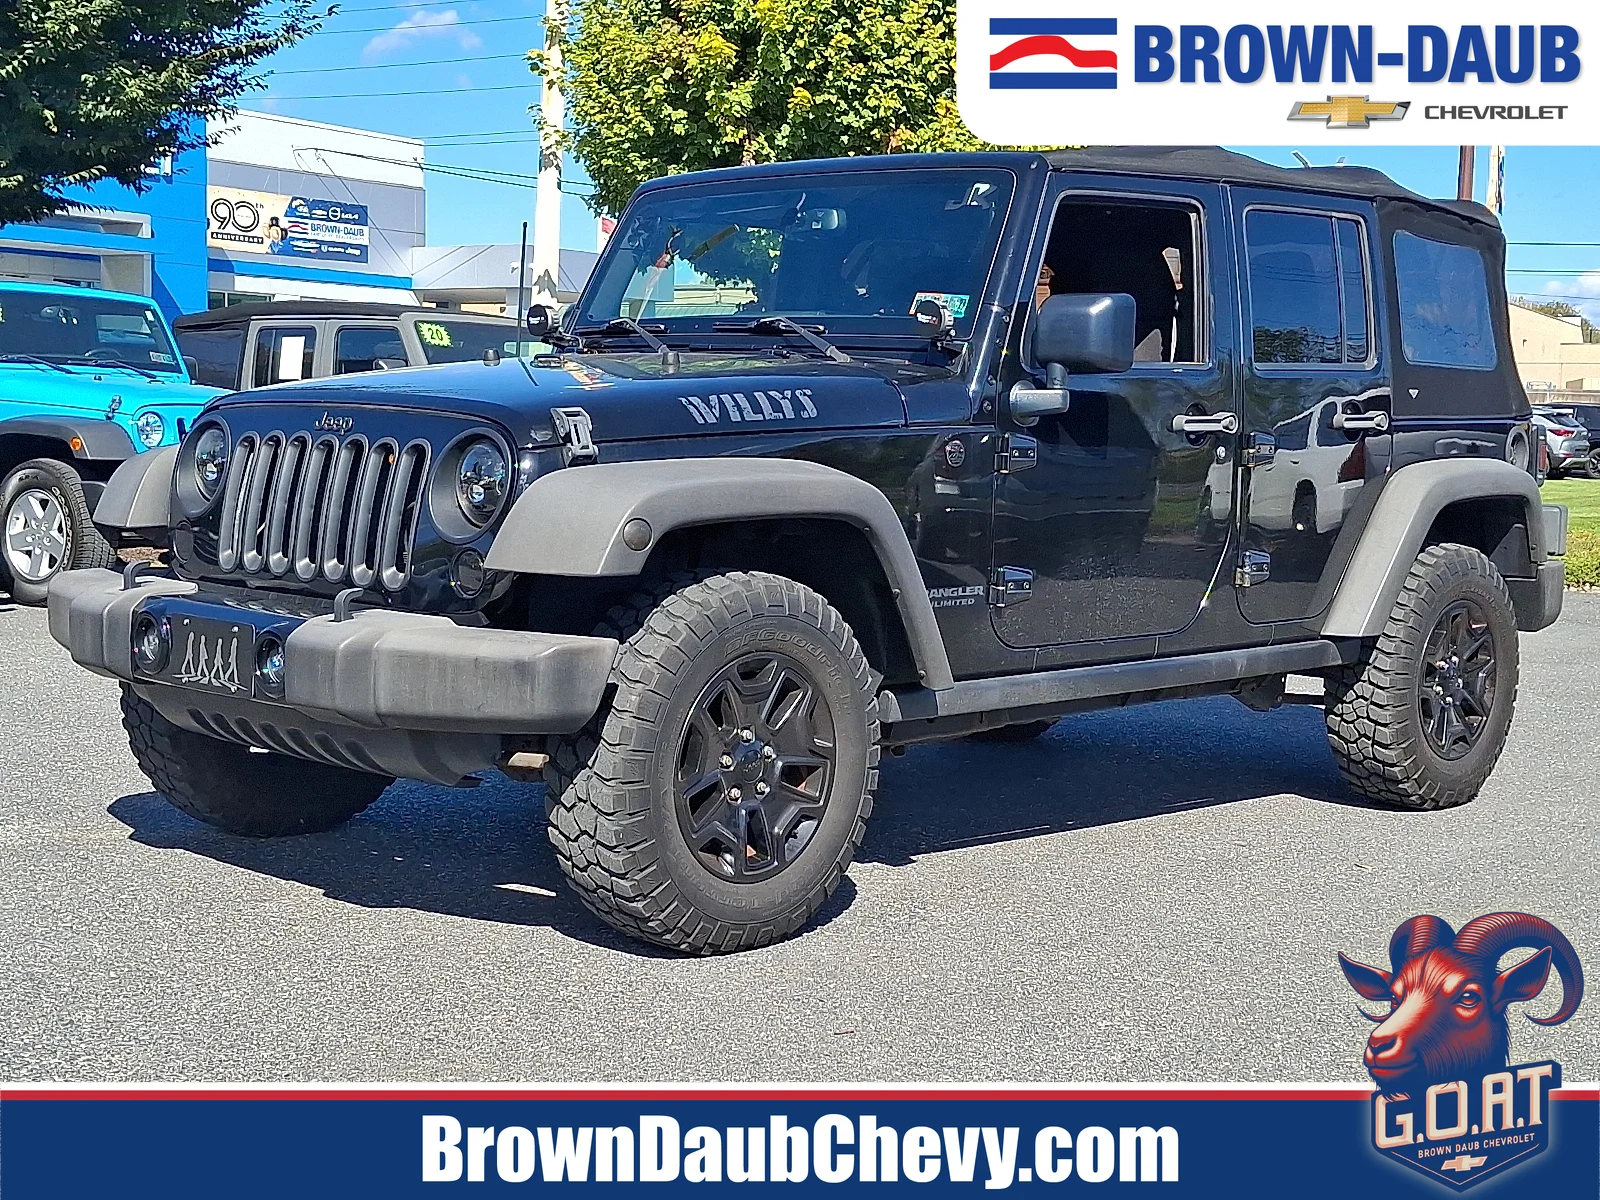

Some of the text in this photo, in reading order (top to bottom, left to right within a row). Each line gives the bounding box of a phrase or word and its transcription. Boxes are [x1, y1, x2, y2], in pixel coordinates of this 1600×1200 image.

[310, 222, 365, 237] BROWN-DAUB
[212, 232, 263, 244] ANNIVERSARY
[427, 327, 444, 341] 20
[677, 388, 818, 425] WILLYS
[314, 410, 354, 436] Jeep
